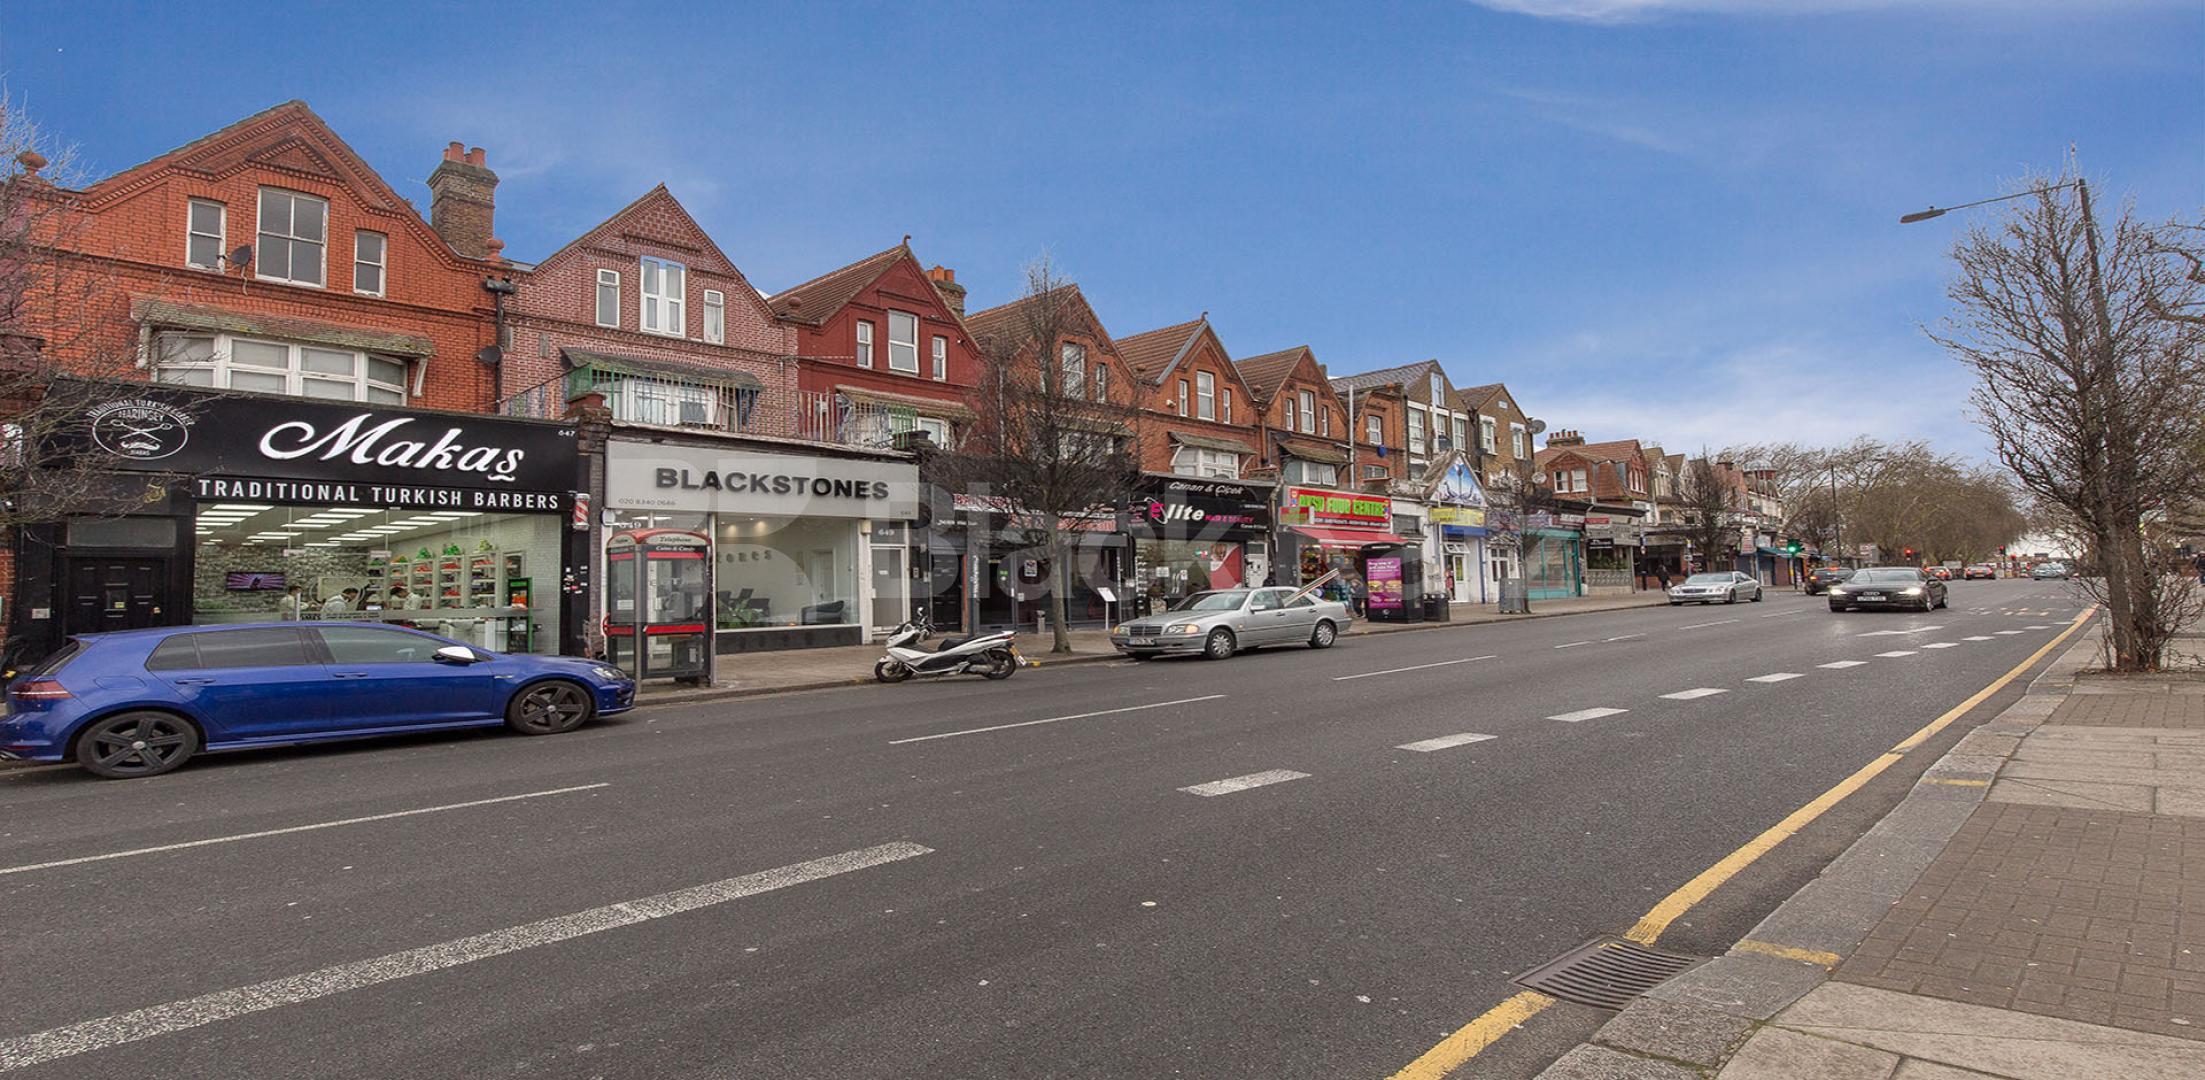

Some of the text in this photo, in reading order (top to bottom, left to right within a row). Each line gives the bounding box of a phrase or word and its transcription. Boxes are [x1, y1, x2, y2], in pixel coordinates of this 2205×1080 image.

[198, 479, 559, 510] TRADITIONAL TURKISH BARBERS
[656, 467, 889, 500] BLACKSTONES
[1169, 481, 1204, 492] Canan
[1204, 484, 1215, 493] &
[1326, 497, 1351, 514] FOOD
